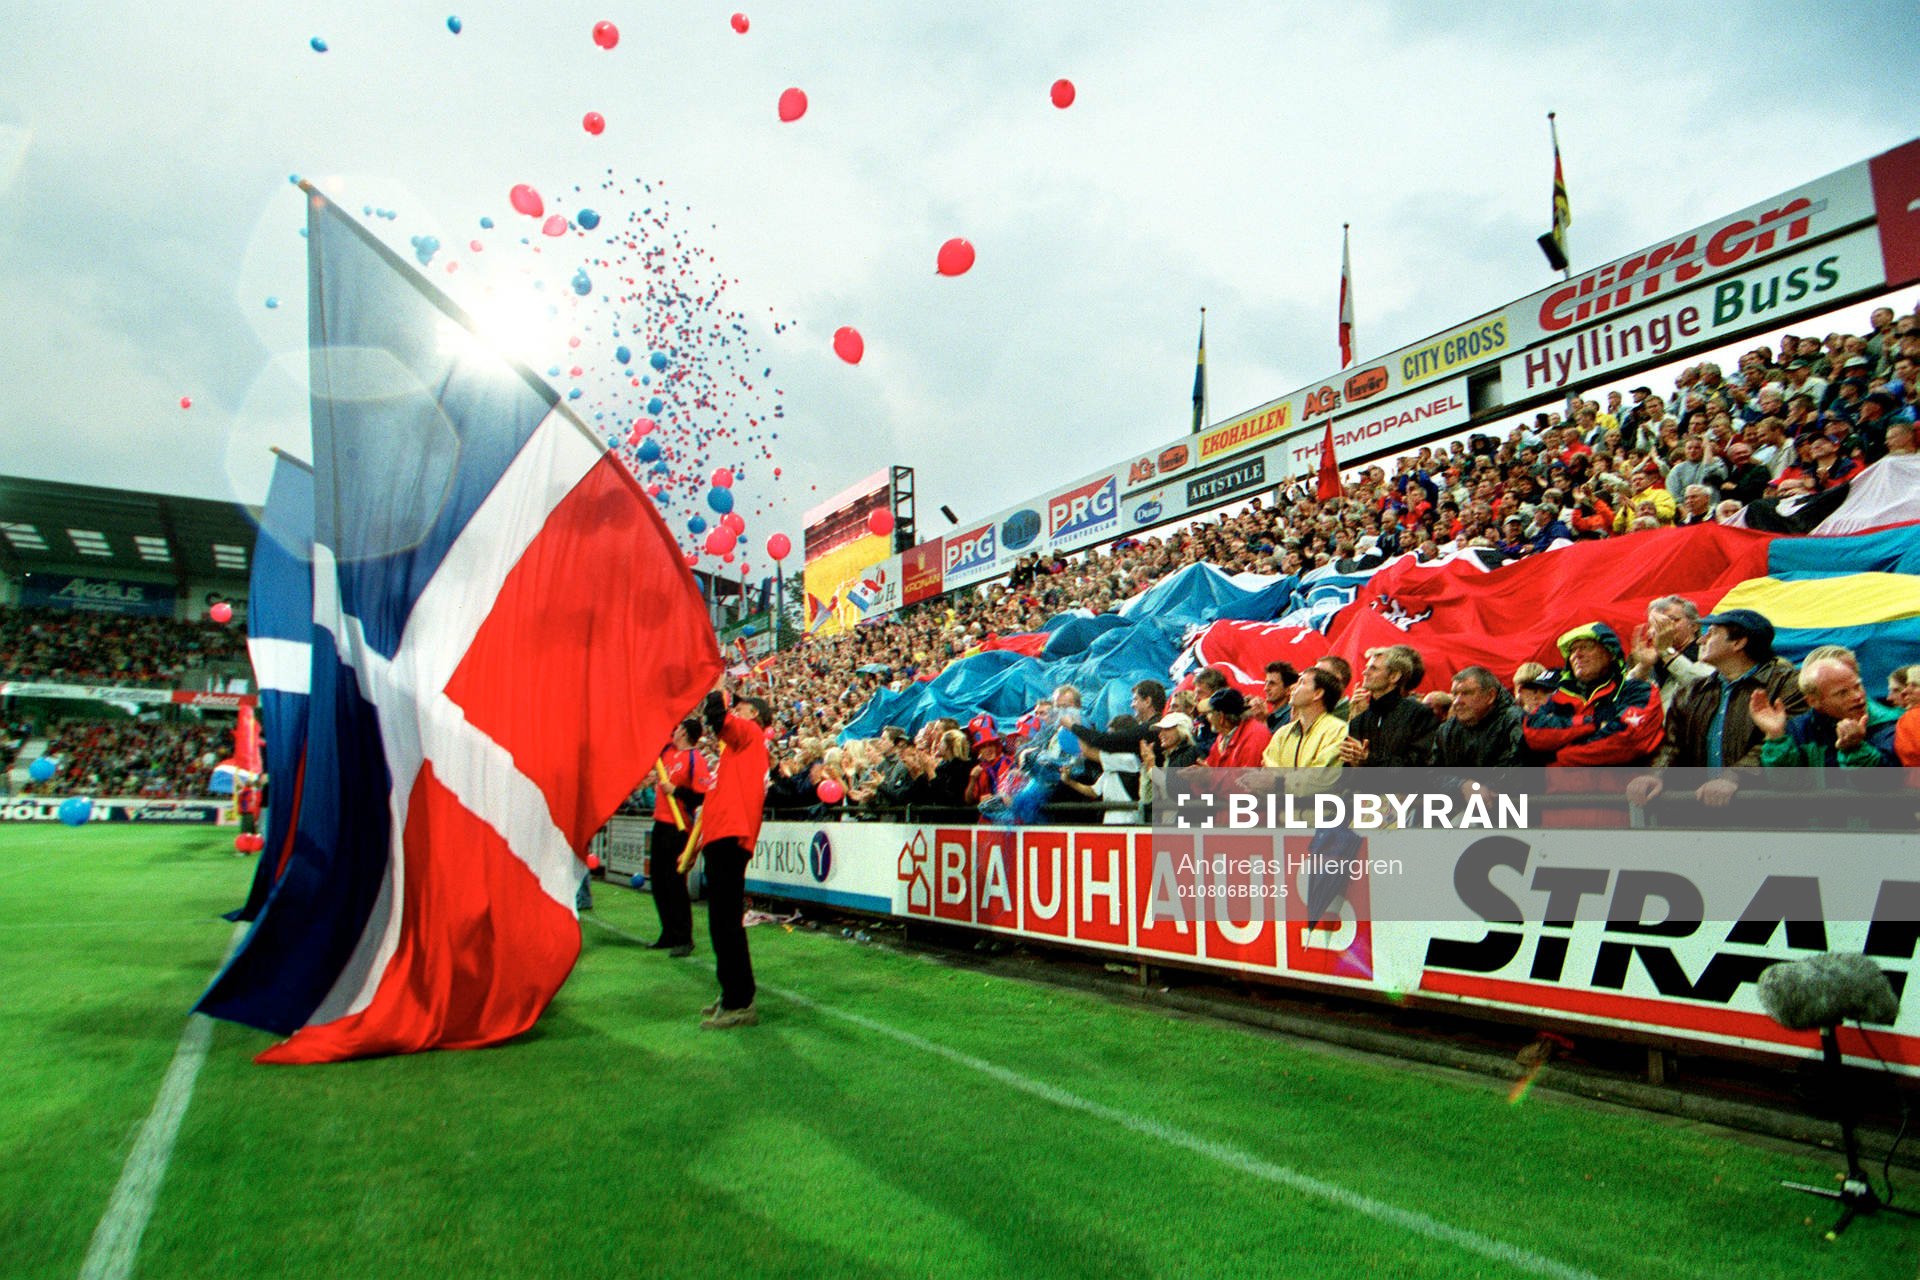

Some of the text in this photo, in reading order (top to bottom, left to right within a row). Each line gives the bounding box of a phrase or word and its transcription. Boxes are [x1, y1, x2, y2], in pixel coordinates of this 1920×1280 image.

[1525, 255, 1840, 389] Hyllinge Buss
[1404, 322, 1505, 380] CITY GROSS
[1202, 406, 1287, 457] EKOHALLEN
[1292, 396, 1463, 462] THERMOPANEL
[1051, 486, 1114, 530] PRG
[1190, 463, 1263, 501] ARTSTYLE
[944, 531, 993, 568] PRG
[941, 842, 1358, 953] BAUHAUS
